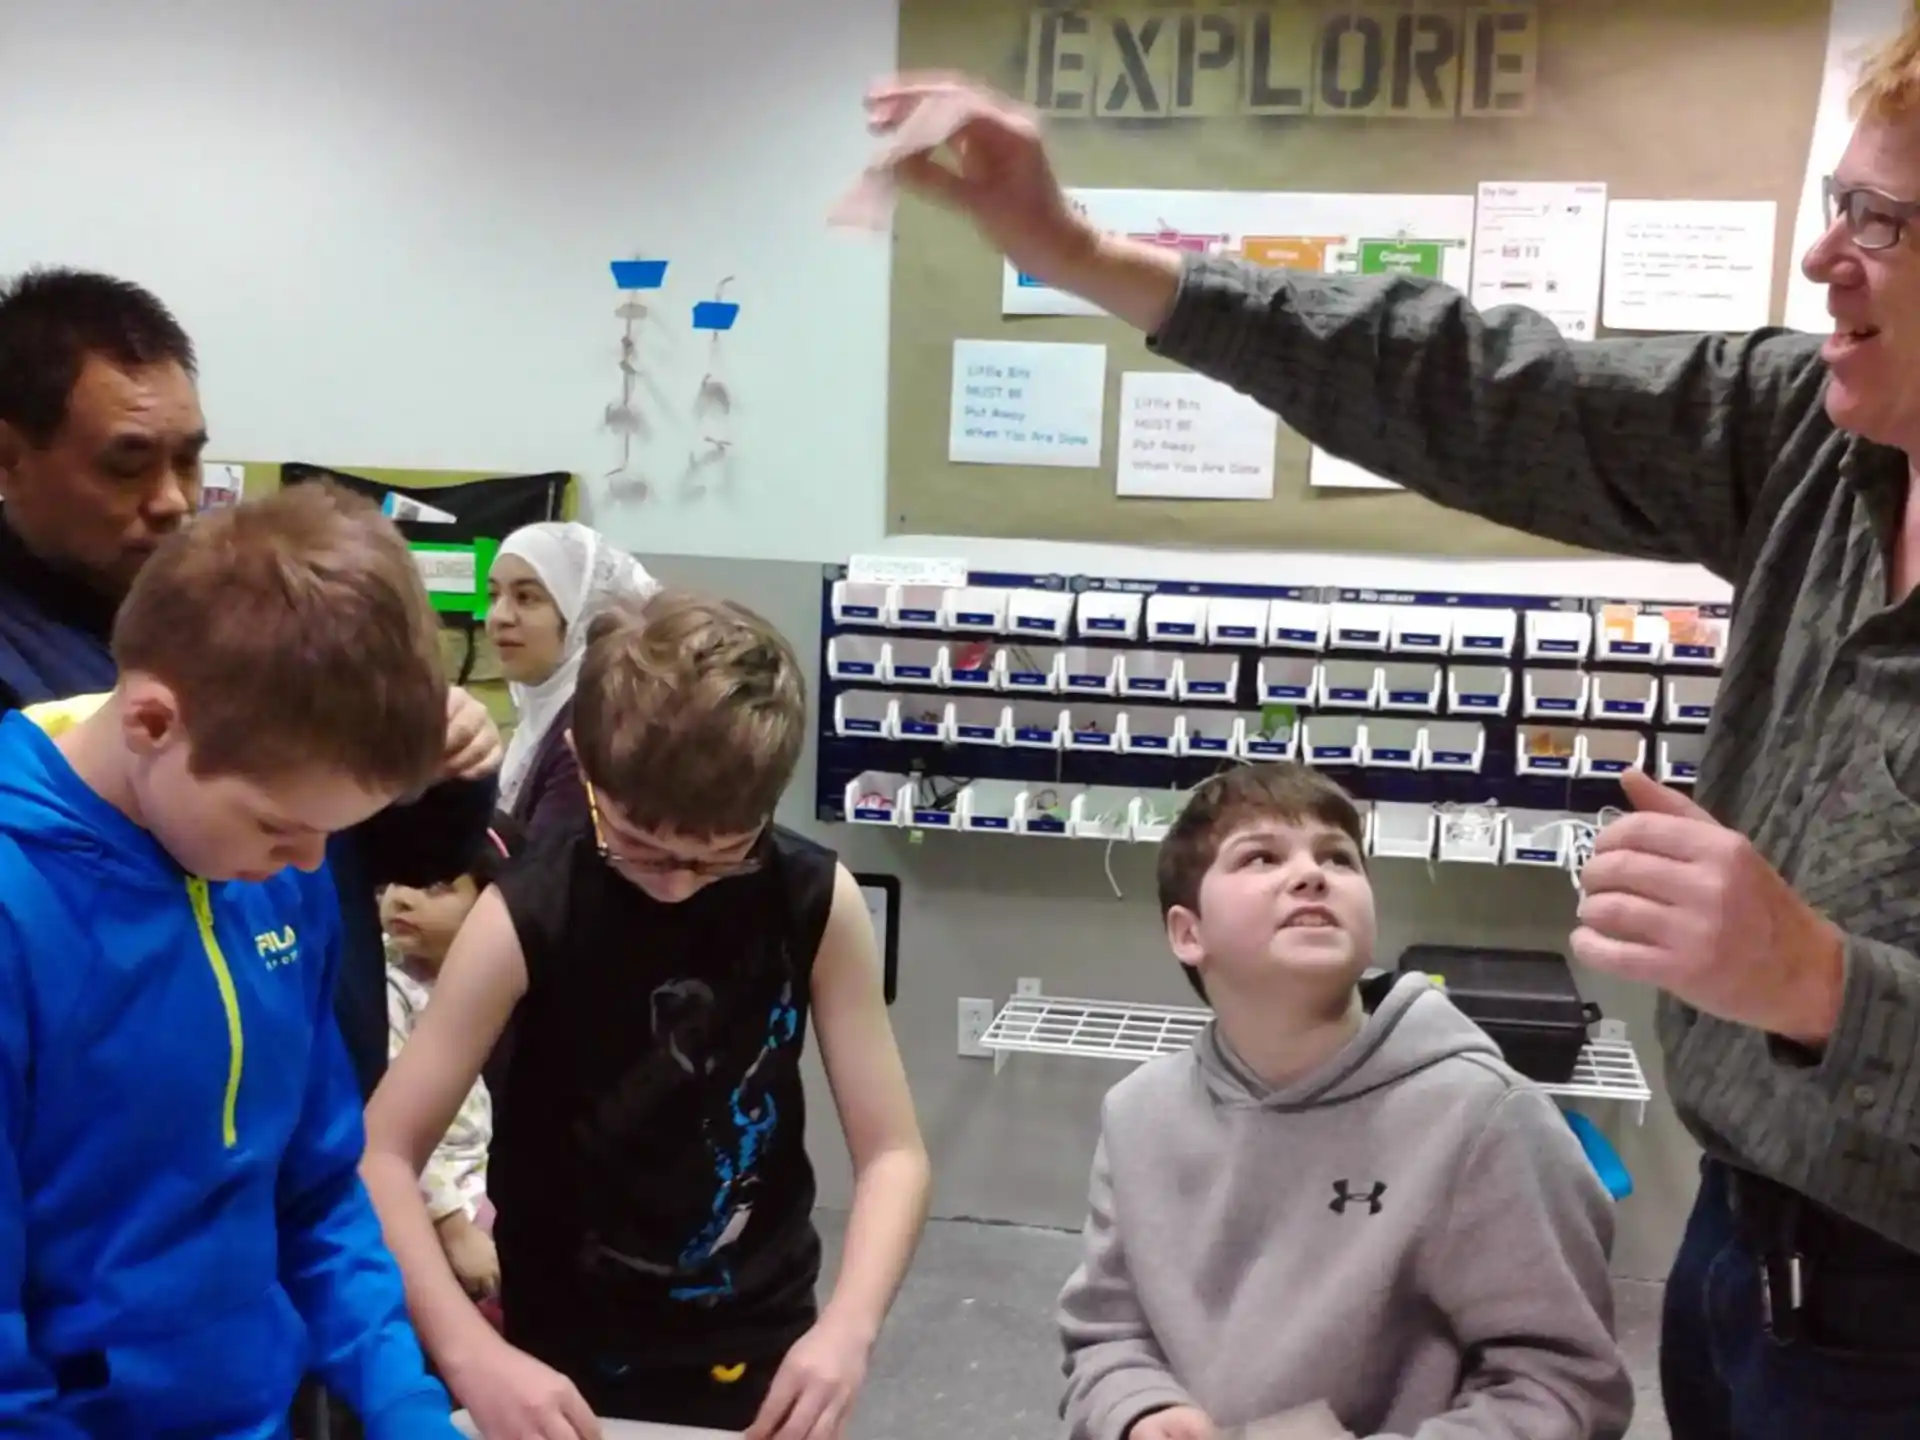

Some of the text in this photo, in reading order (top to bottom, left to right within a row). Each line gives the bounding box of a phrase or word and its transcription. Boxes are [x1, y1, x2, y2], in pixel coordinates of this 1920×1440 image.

[1036, 10, 1531, 110] EXPLORE
[965, 384, 1002, 398] MUST
[964, 405, 1026, 424] Put Away
[1134, 418, 1171, 431] MUST
[965, 427, 1089, 445] When You Are Done
[1133, 439, 1195, 454] Put Away
[1132, 460, 1262, 474] When You Are Done
[254, 924, 296, 957] FILA
